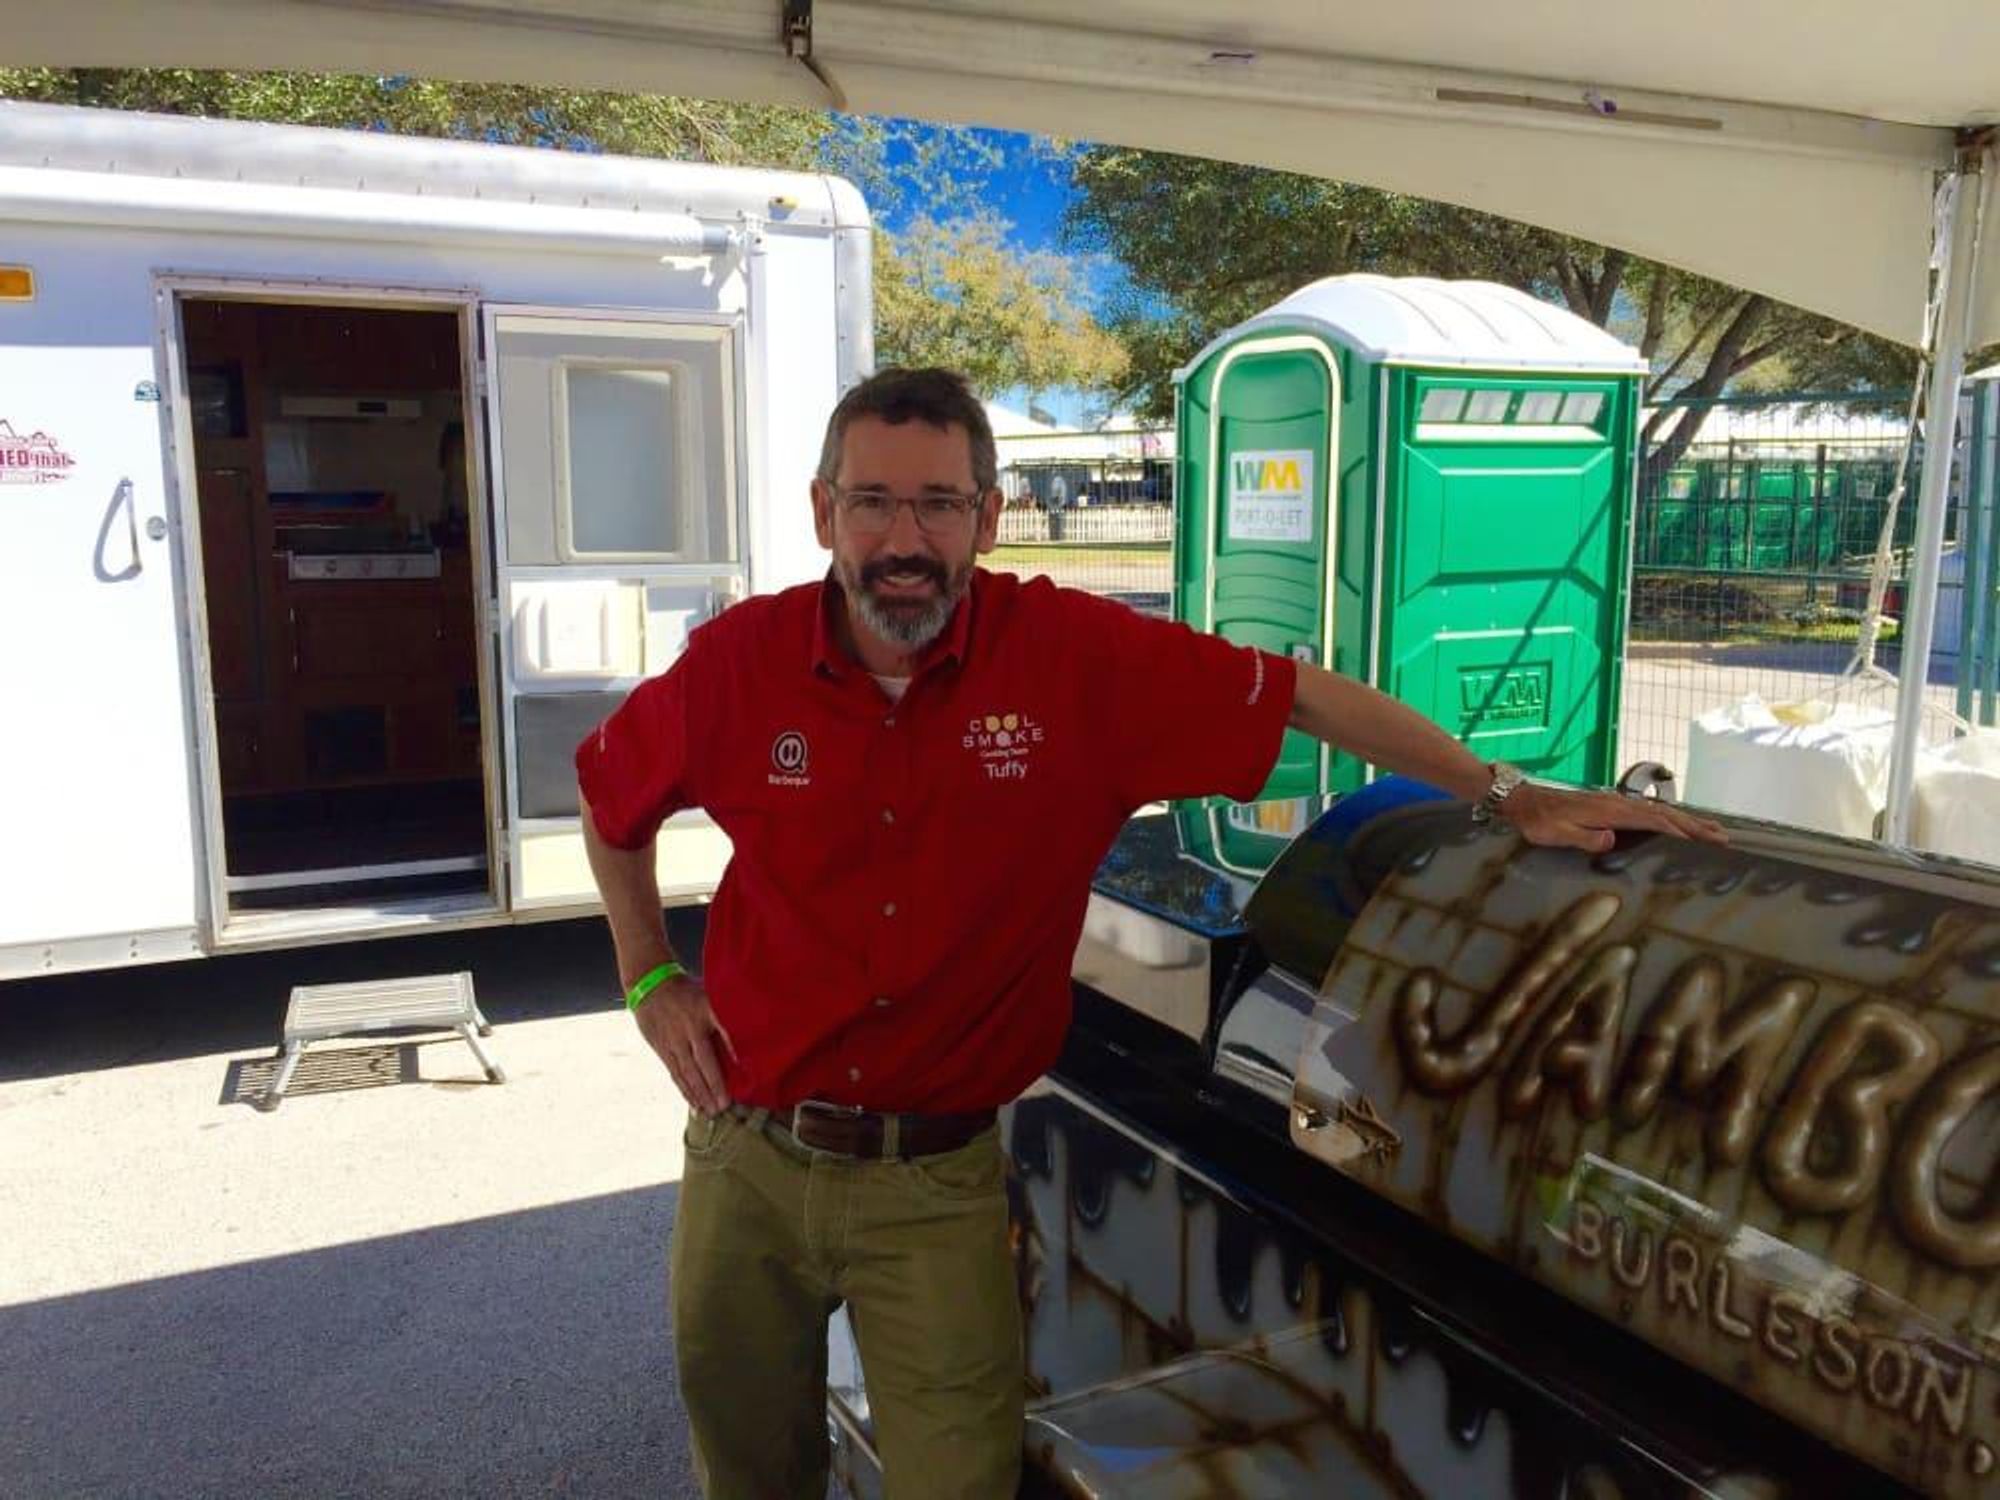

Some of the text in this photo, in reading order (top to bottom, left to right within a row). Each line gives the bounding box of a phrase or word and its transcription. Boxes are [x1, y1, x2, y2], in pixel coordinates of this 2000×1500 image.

[1235, 460, 1302, 492] WM
[962, 728, 1046, 749] SMOKE
[983, 760, 1028, 779] Tuffy
